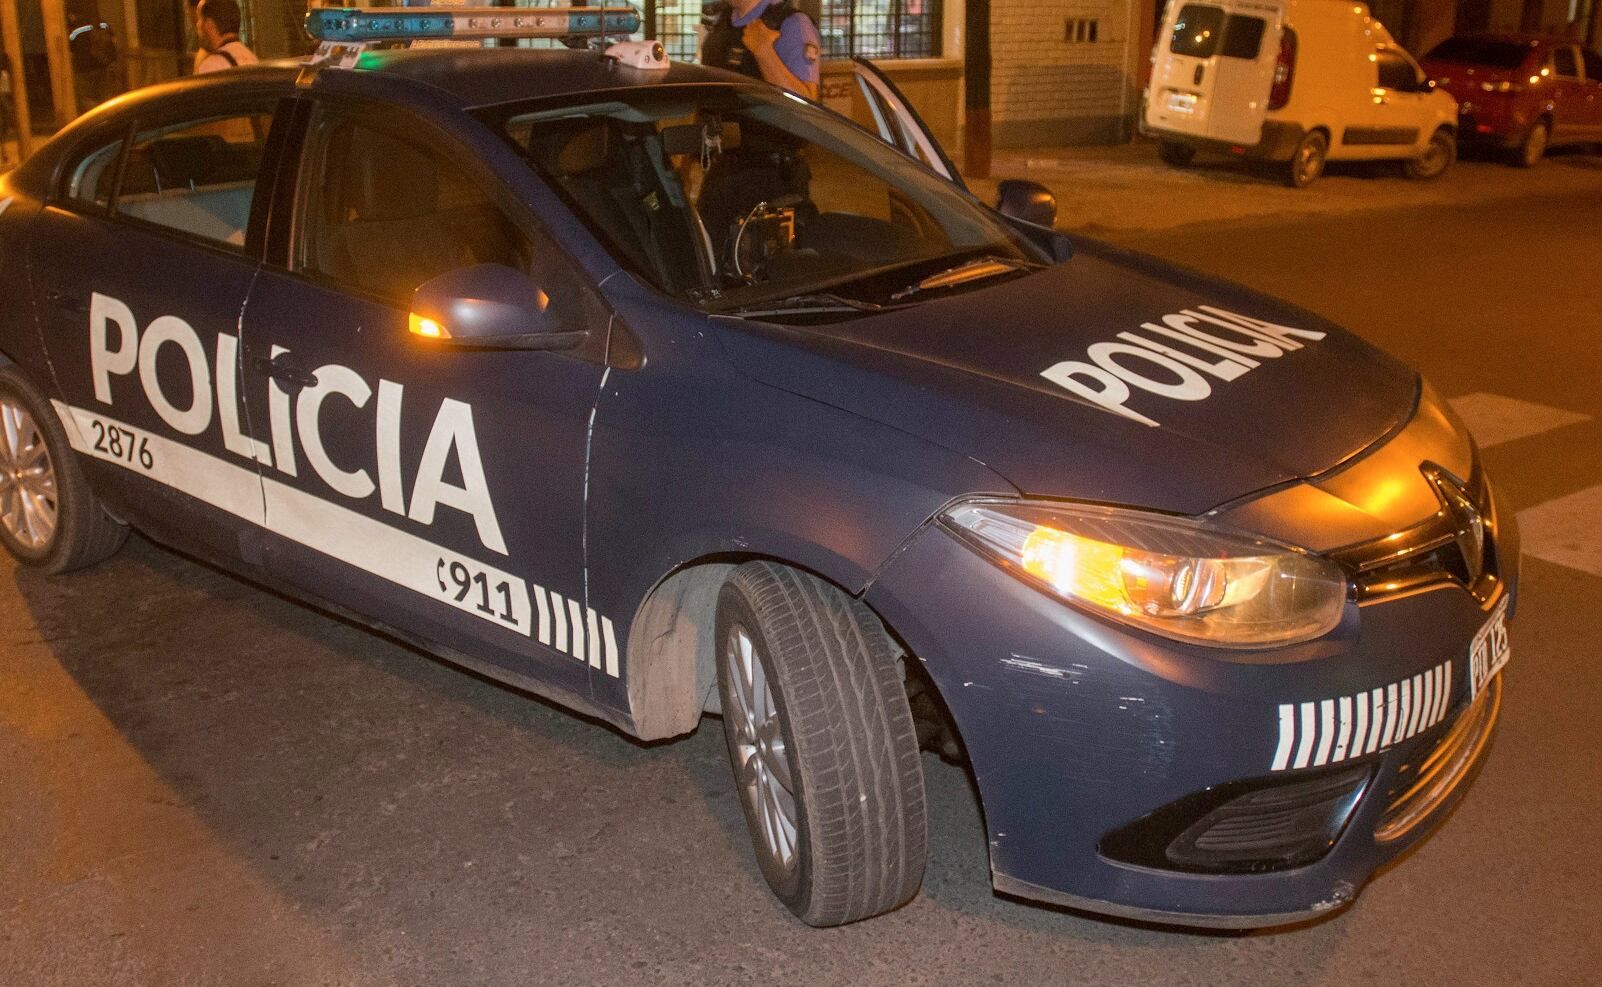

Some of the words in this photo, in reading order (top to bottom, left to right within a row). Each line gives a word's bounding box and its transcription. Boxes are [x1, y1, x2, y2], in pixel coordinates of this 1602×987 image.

[1039, 304, 1326, 427] POLICIA
[92, 420, 153, 470] 2876
[449, 561, 519, 626] 911
